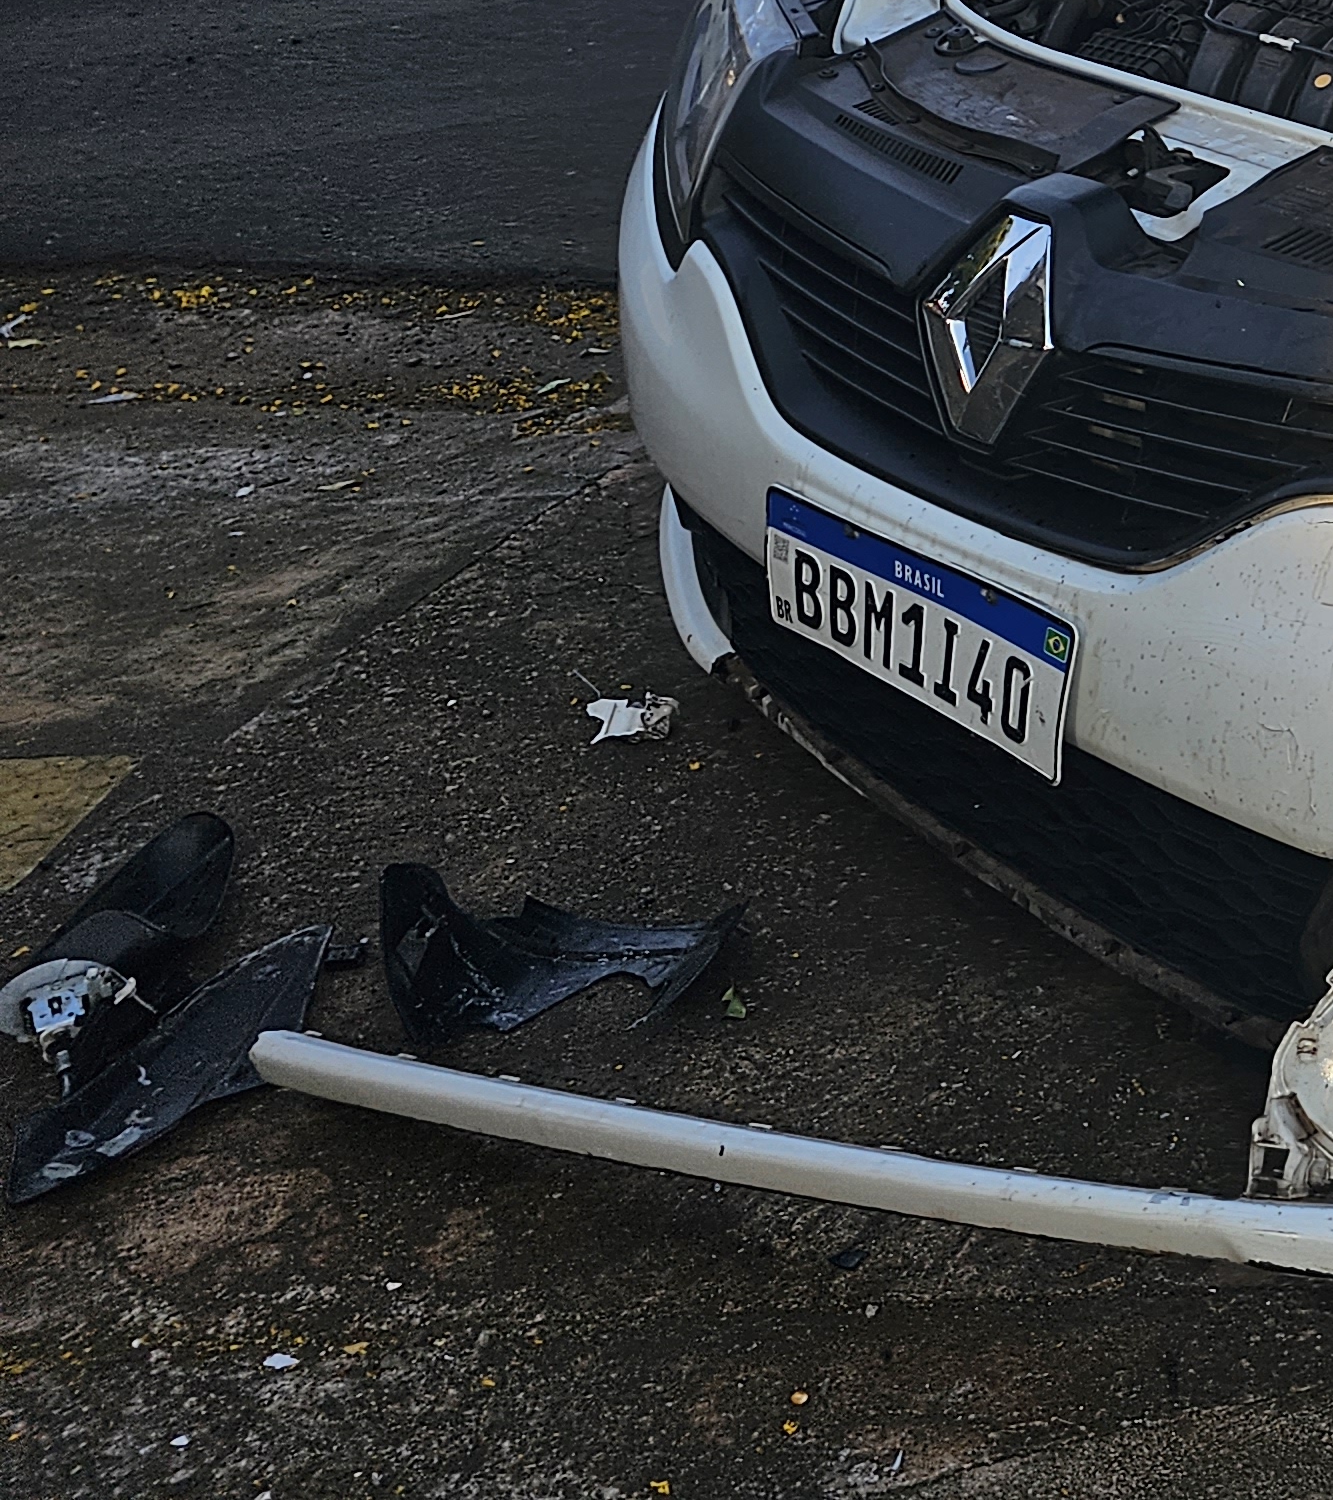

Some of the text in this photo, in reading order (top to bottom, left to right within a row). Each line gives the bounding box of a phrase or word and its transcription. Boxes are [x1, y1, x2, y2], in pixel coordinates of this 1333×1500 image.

[894, 559, 945, 598] BRASIL
[775, 595, 794, 625] BR
[794, 547, 1034, 745] BBM1I40
